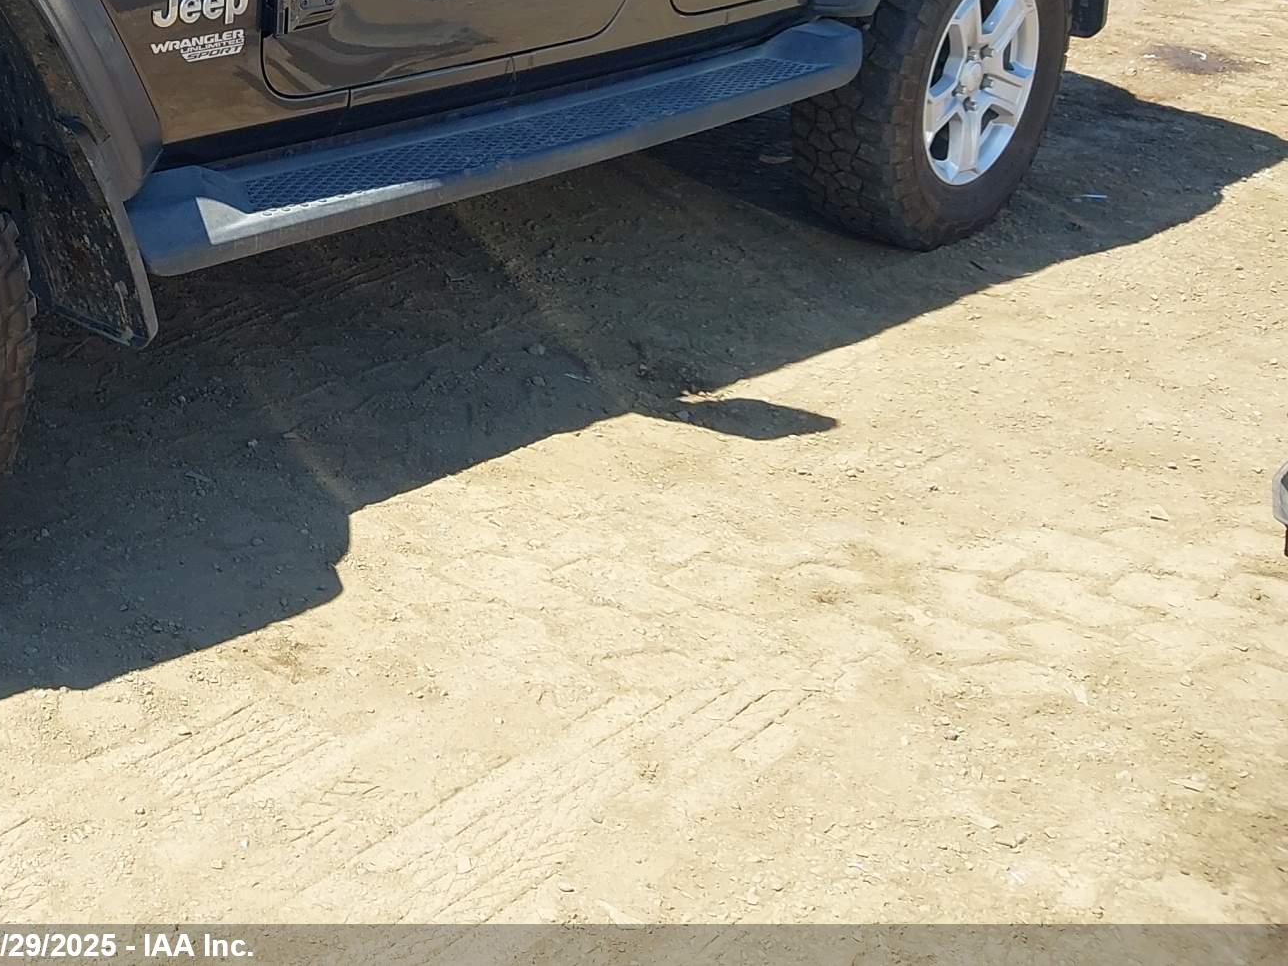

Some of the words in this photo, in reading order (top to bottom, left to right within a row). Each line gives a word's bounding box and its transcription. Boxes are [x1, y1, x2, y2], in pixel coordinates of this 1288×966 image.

[150, 29, 244, 54] WRANGLER
[180, 38, 245, 54] UNLIMITED
[187, 46, 242, 60] SPORT
